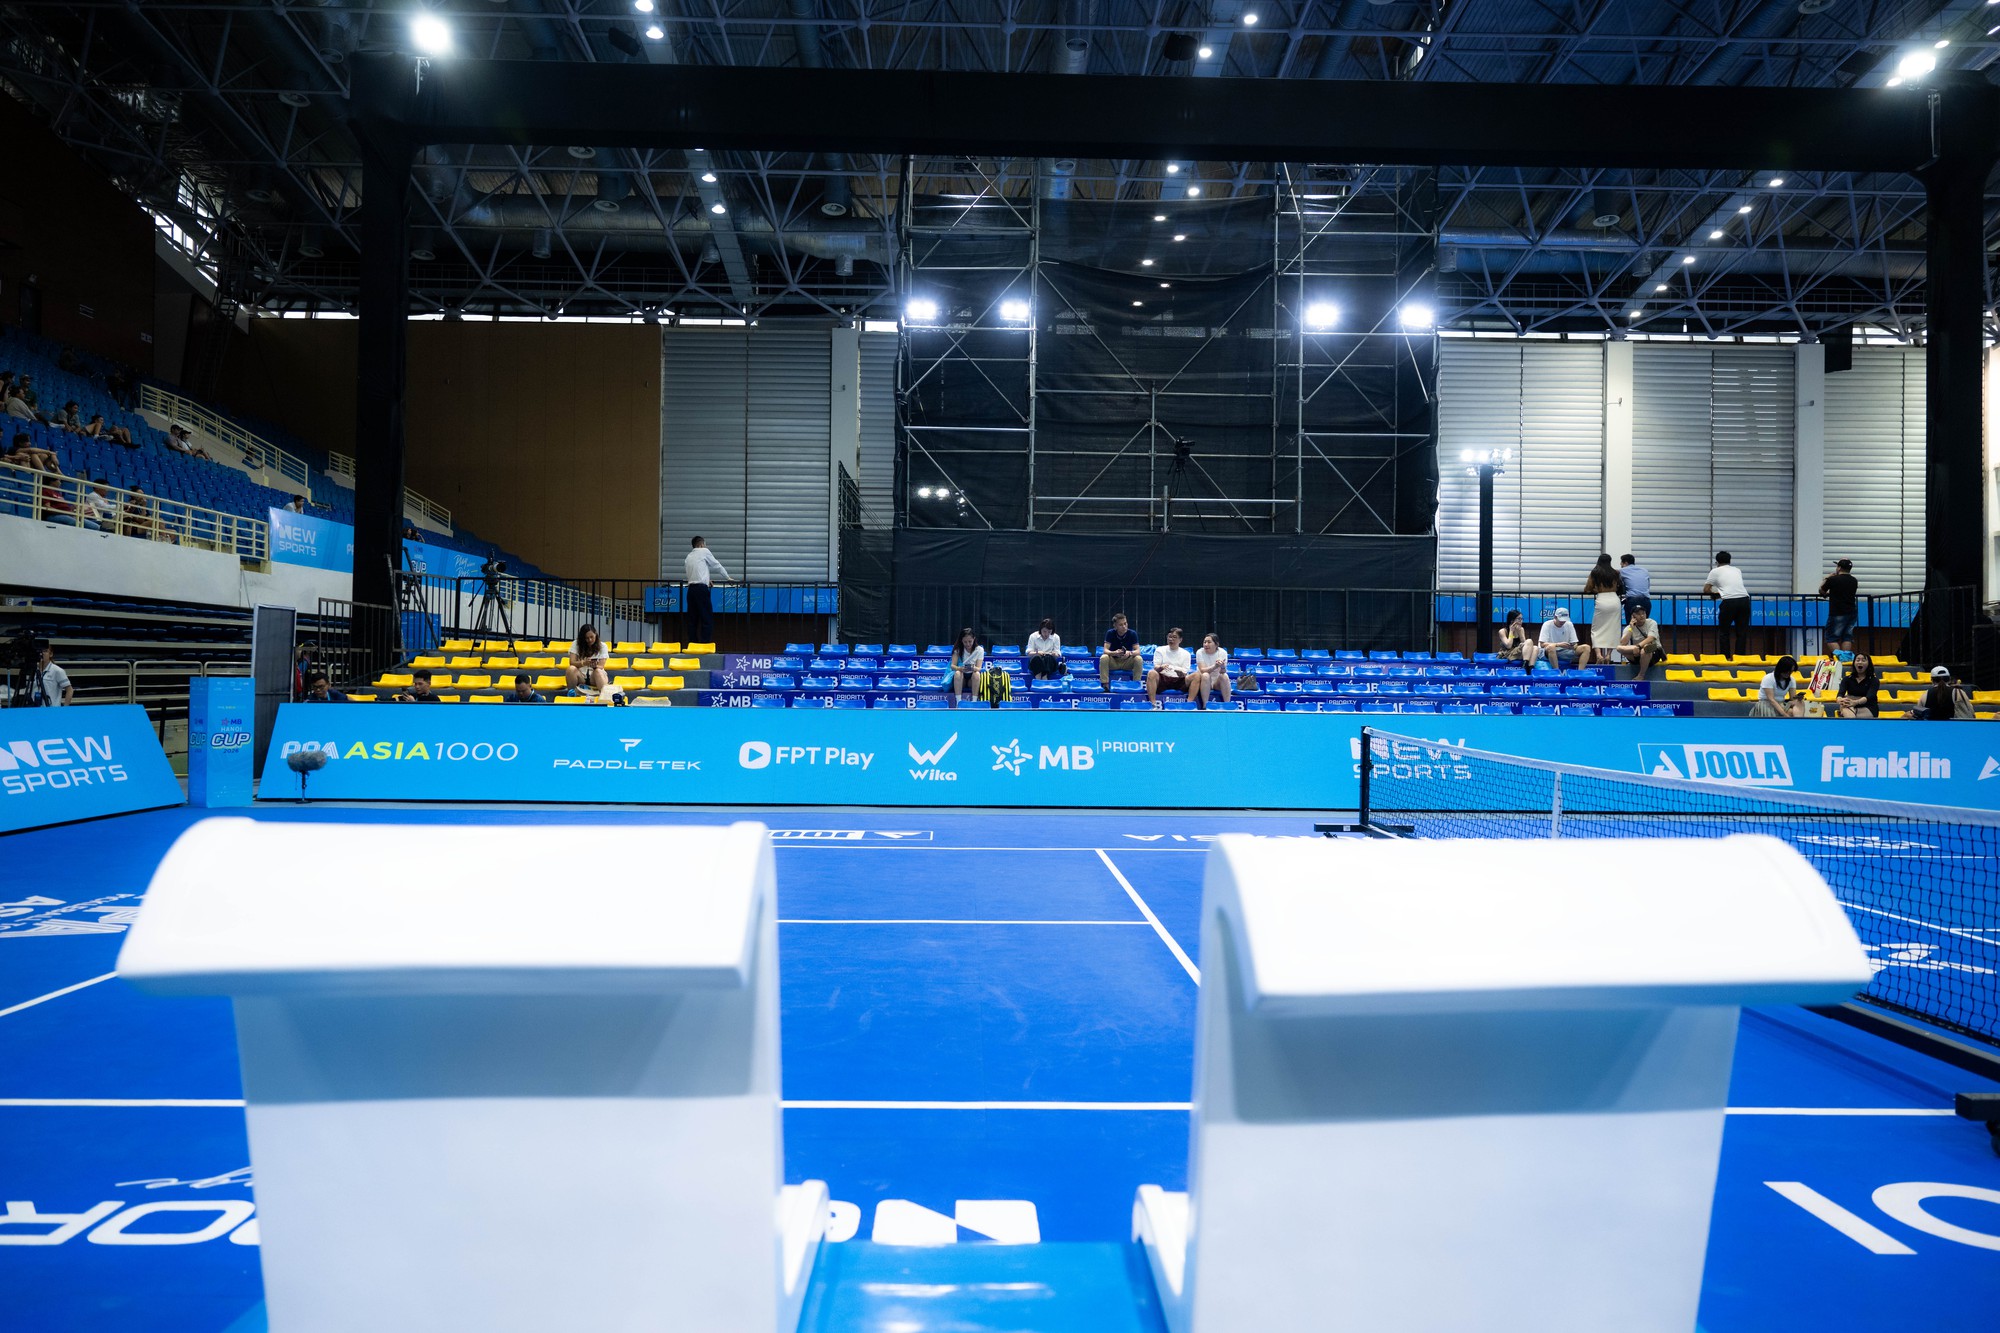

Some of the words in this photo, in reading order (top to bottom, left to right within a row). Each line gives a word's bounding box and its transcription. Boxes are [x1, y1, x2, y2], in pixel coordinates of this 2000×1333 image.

[279, 526, 317, 544] NEW
[279, 541, 317, 557] SPORTS
[752, 658, 772, 669] MB
[739, 675, 760, 686] MB
[729, 696, 751, 707] MB
[211, 732, 251, 747] CUP
[0, 735, 112, 770] NEW
[344, 741, 430, 760] ASIA
[434, 742, 519, 761] 1000
[775, 746, 821, 764] FPT
[825, 747, 874, 770] Play
[1039, 745, 1095, 770] MB
[1102, 741, 1175, 752] PRIORITY
[553, 759, 702, 771] PADDLETEK
[1353, 764, 1472, 779] SPORTS
[1694, 750, 1788, 780] JOOLA
[2, 764, 128, 795] SPORTS
[908, 769, 957, 781] Wika
